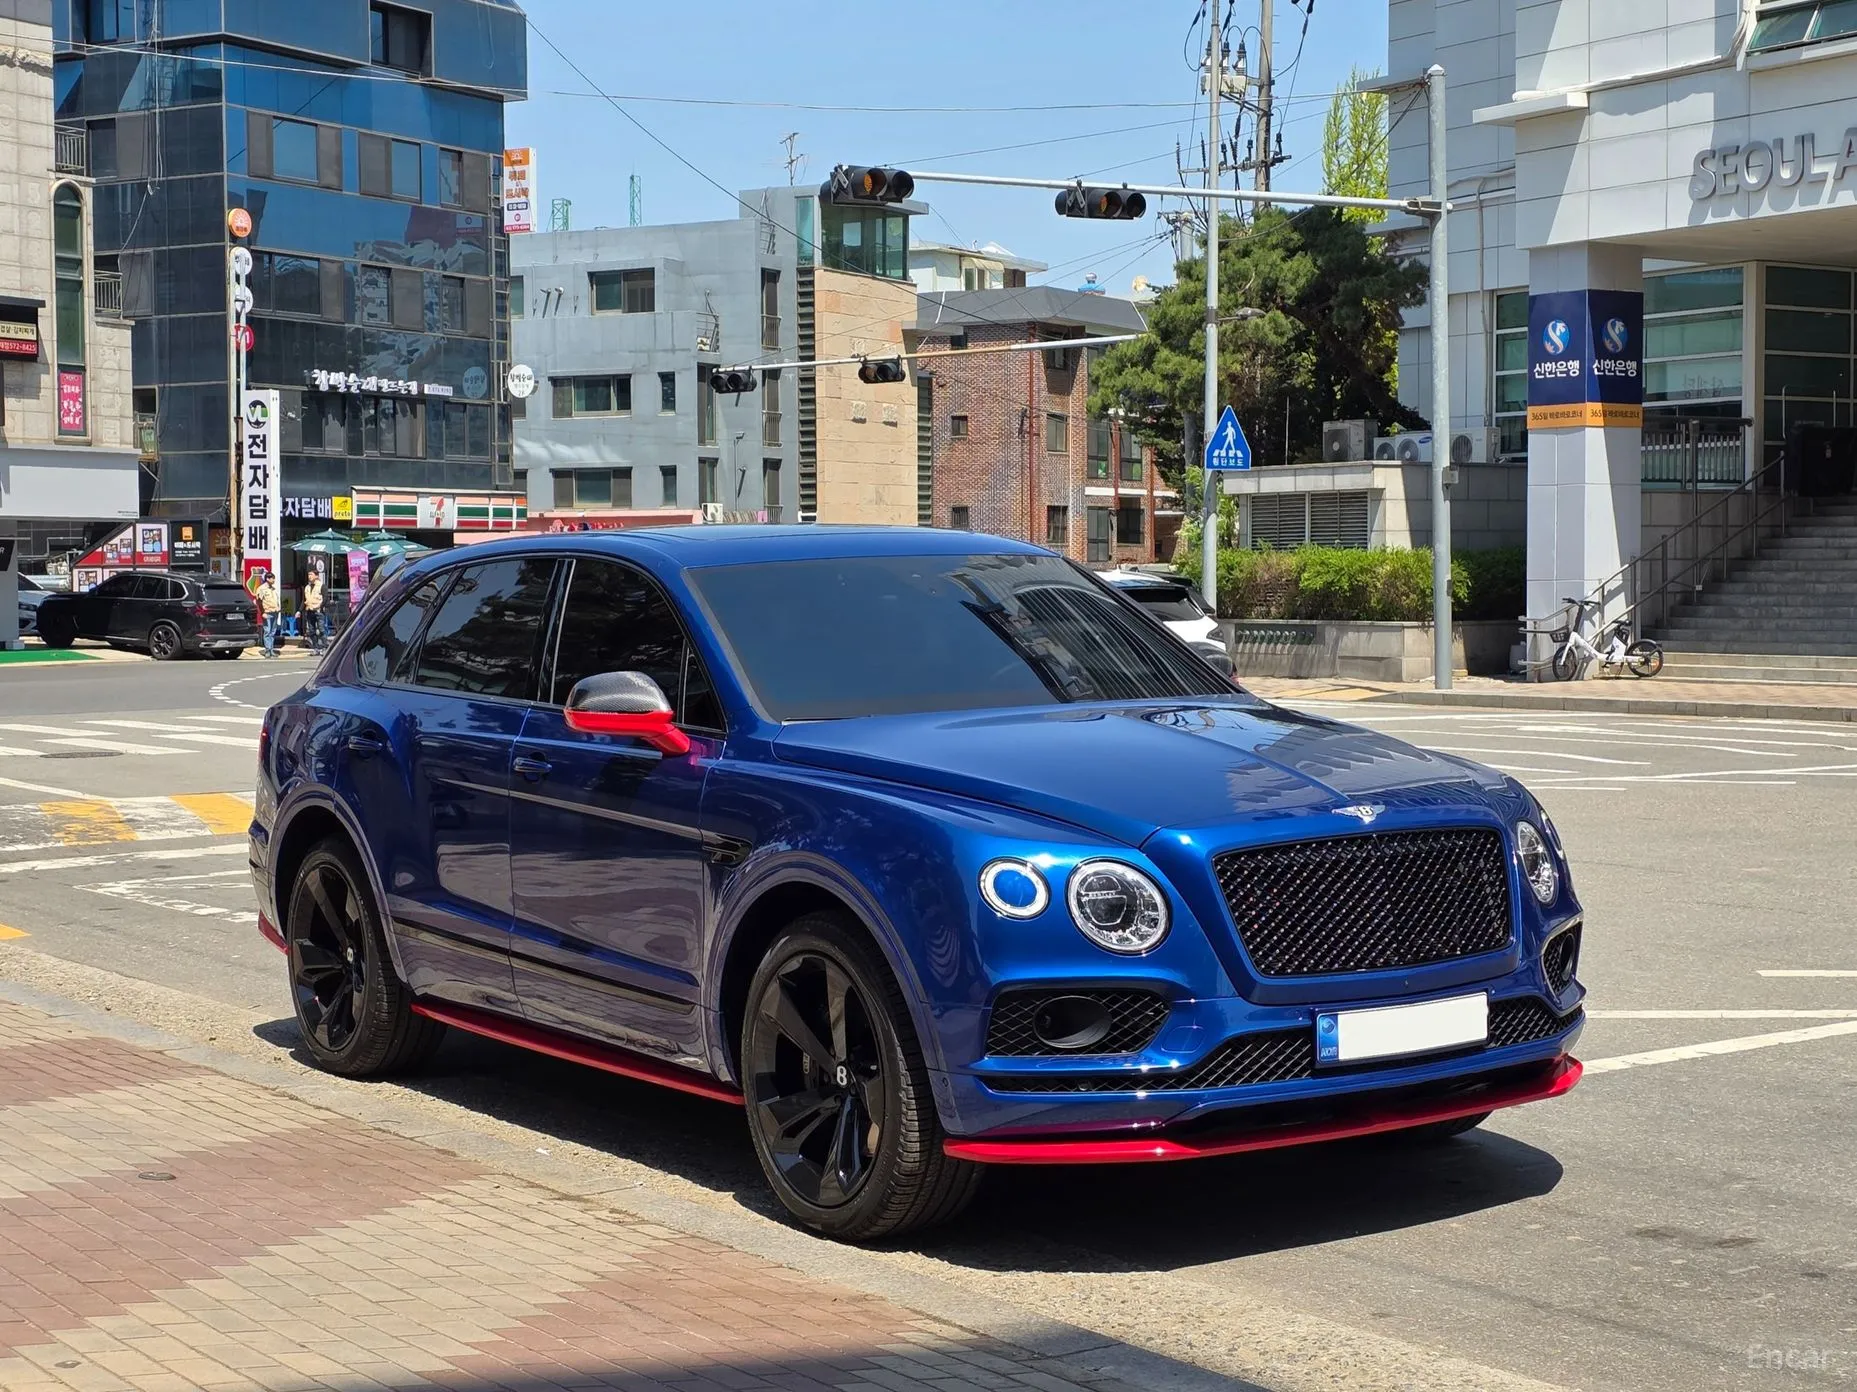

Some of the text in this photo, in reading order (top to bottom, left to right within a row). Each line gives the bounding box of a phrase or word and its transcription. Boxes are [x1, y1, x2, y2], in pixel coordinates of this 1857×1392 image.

[1534, 360, 1580, 379] 신한은행
[1593, 359, 1637, 377] 신한은행
[247, 434, 270, 550] 전자담배
